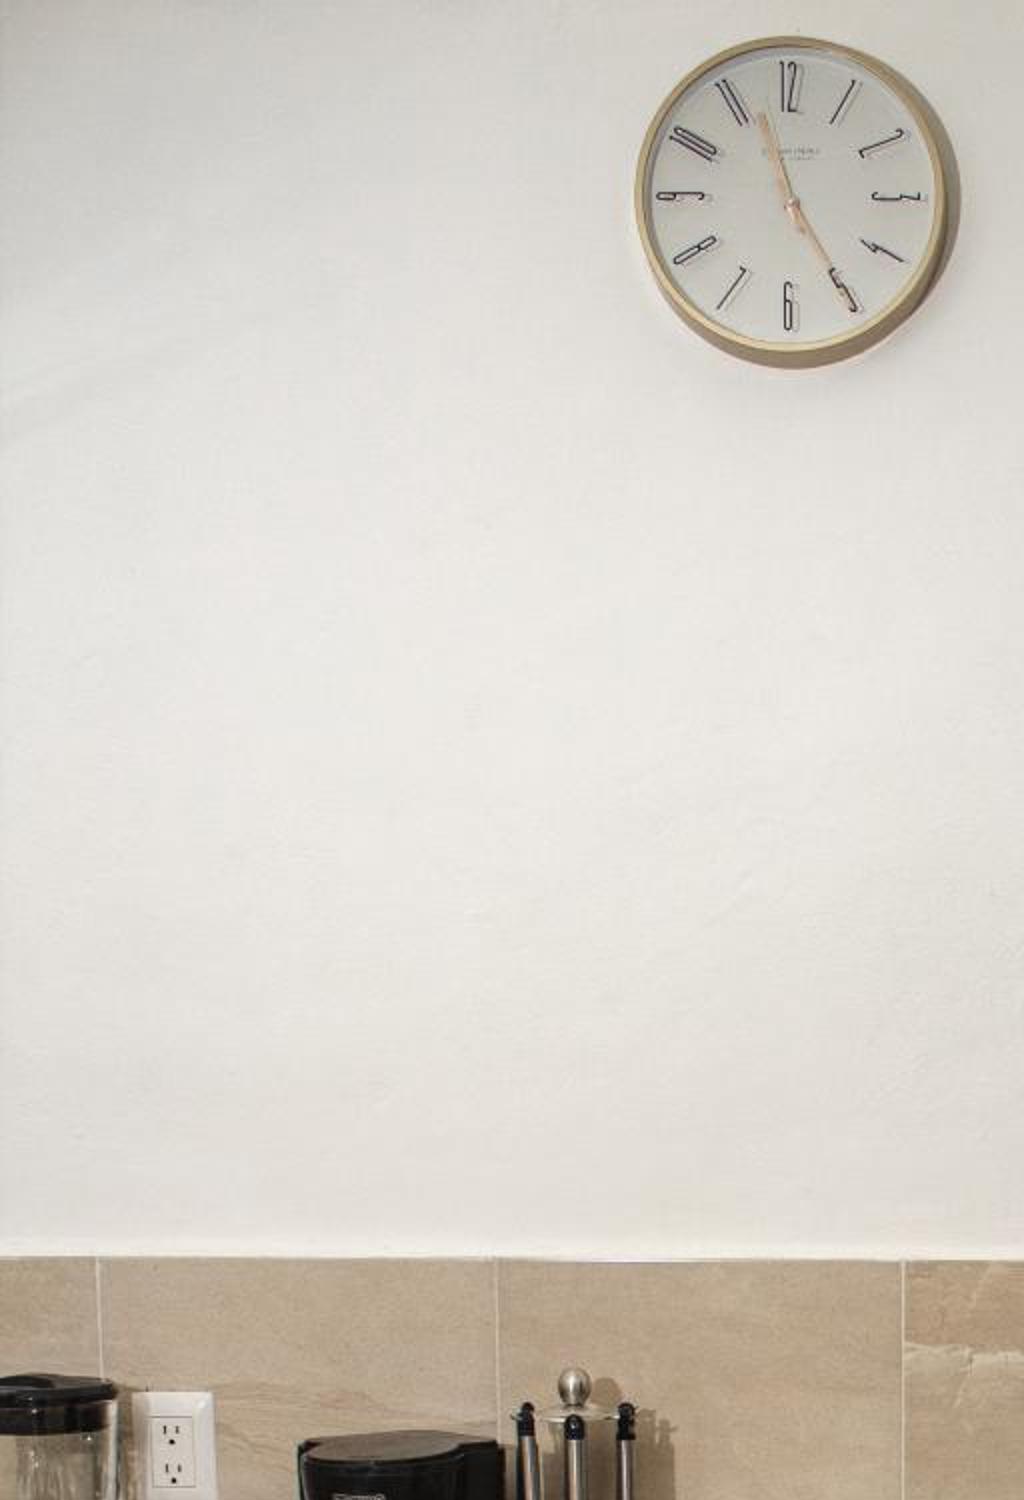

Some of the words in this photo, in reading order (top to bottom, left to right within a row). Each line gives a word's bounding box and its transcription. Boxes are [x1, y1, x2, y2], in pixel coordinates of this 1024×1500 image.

[715, 79, 748, 126] 11
[780, 61, 797, 112] 12
[830, 80, 856, 124] 1
[669, 126, 717, 162] 10
[859, 128, 904, 158] 2
[656, 192, 705, 201] 9
[871, 192, 920, 201] 3
[673, 236, 717, 265] 8
[861, 240, 904, 262] 4
[717, 266, 746, 309] 7
[784, 281, 792, 331] 6
[828, 267, 858, 312] 5
